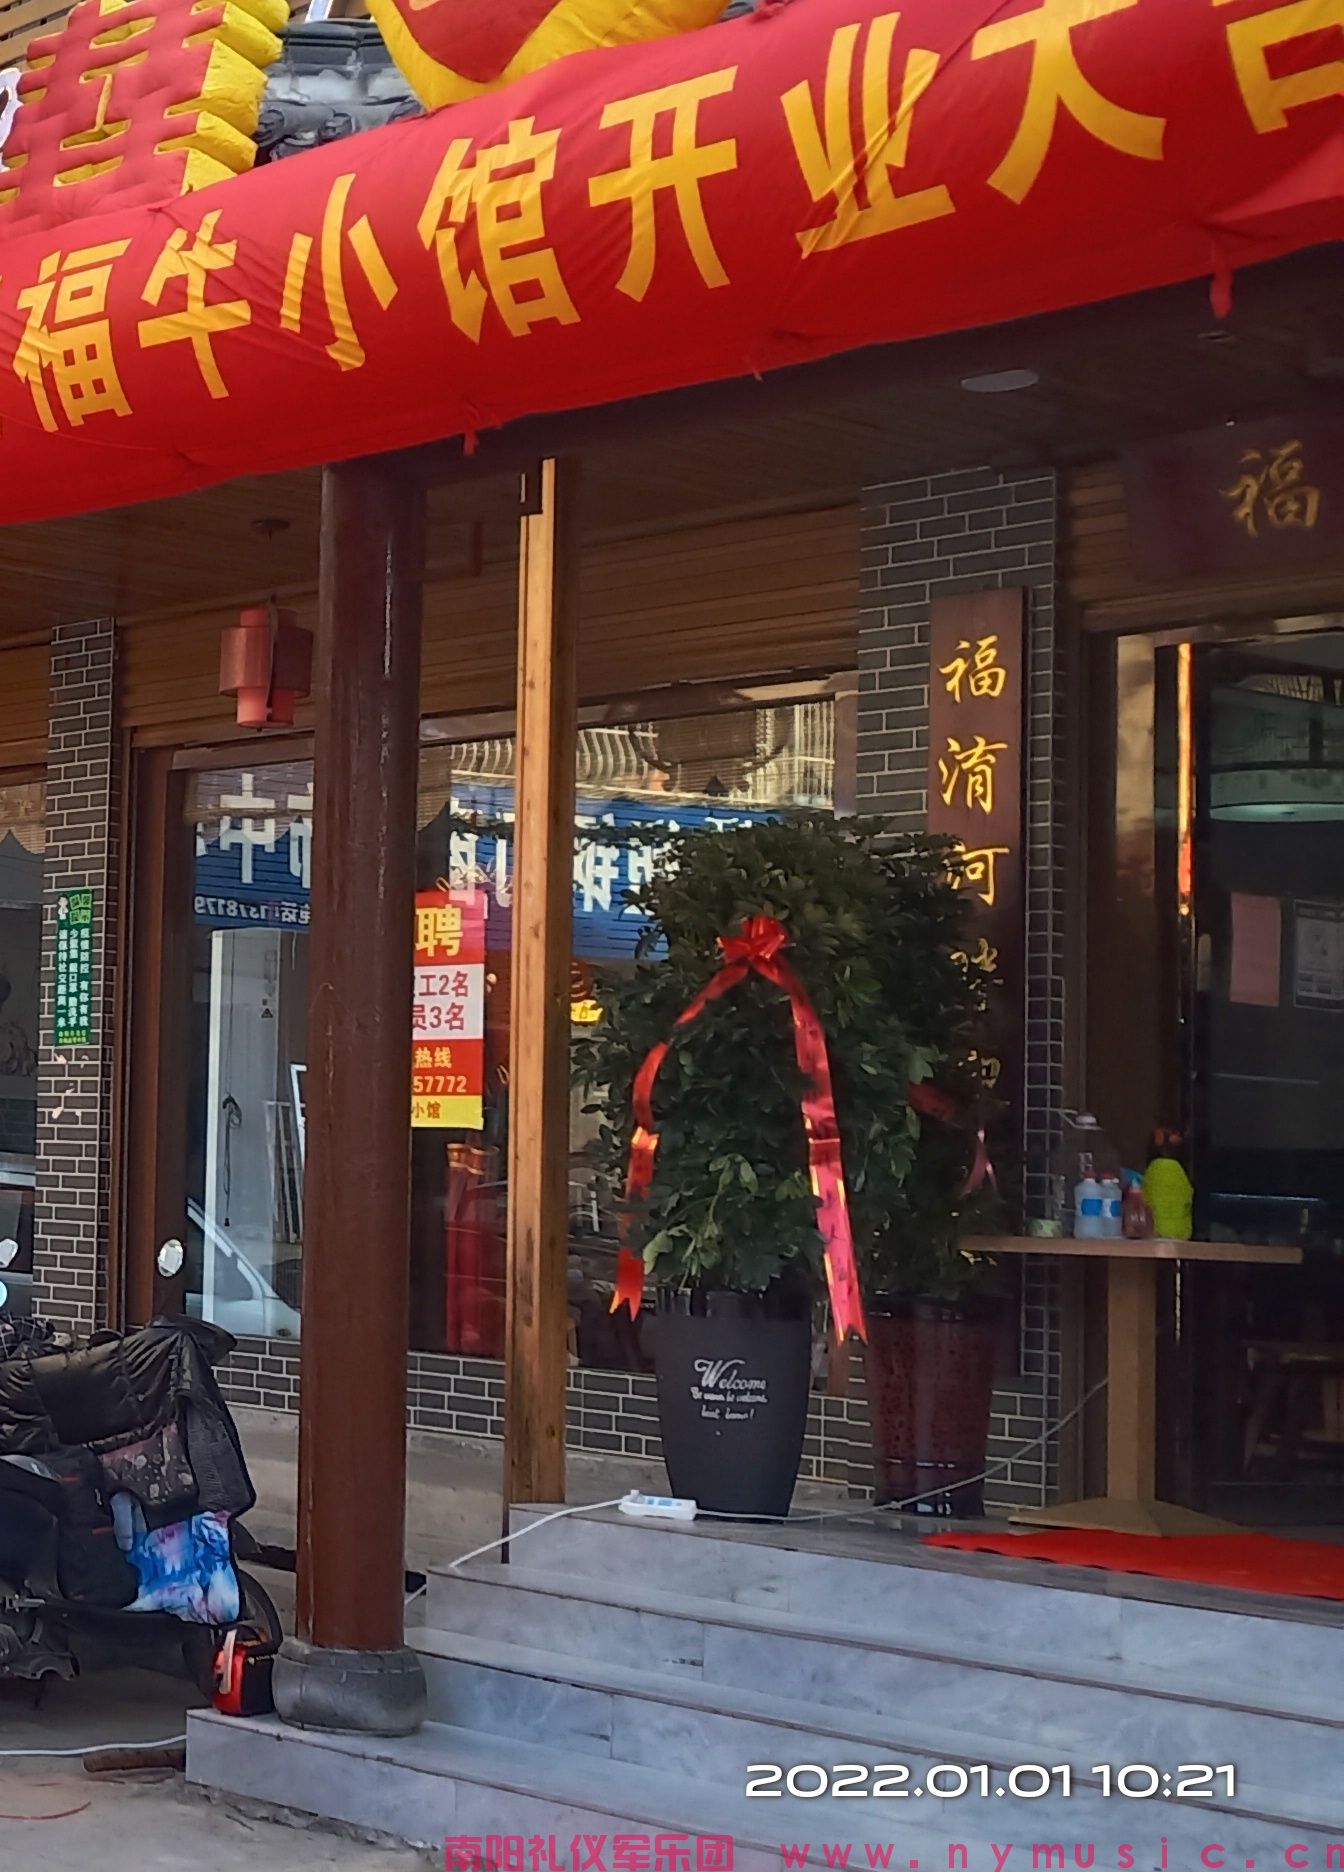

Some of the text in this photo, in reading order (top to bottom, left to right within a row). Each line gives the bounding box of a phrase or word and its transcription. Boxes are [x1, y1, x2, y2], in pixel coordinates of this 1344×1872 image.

[1220, 440, 1320, 537] 福
[416, 903, 464, 957] 聘
[412, 971, 470, 998] 工2名
[415, 1047, 453, 1069] 热线
[413, 1075, 467, 1093] 57772
[694, 1358, 767, 1390] Welcome
